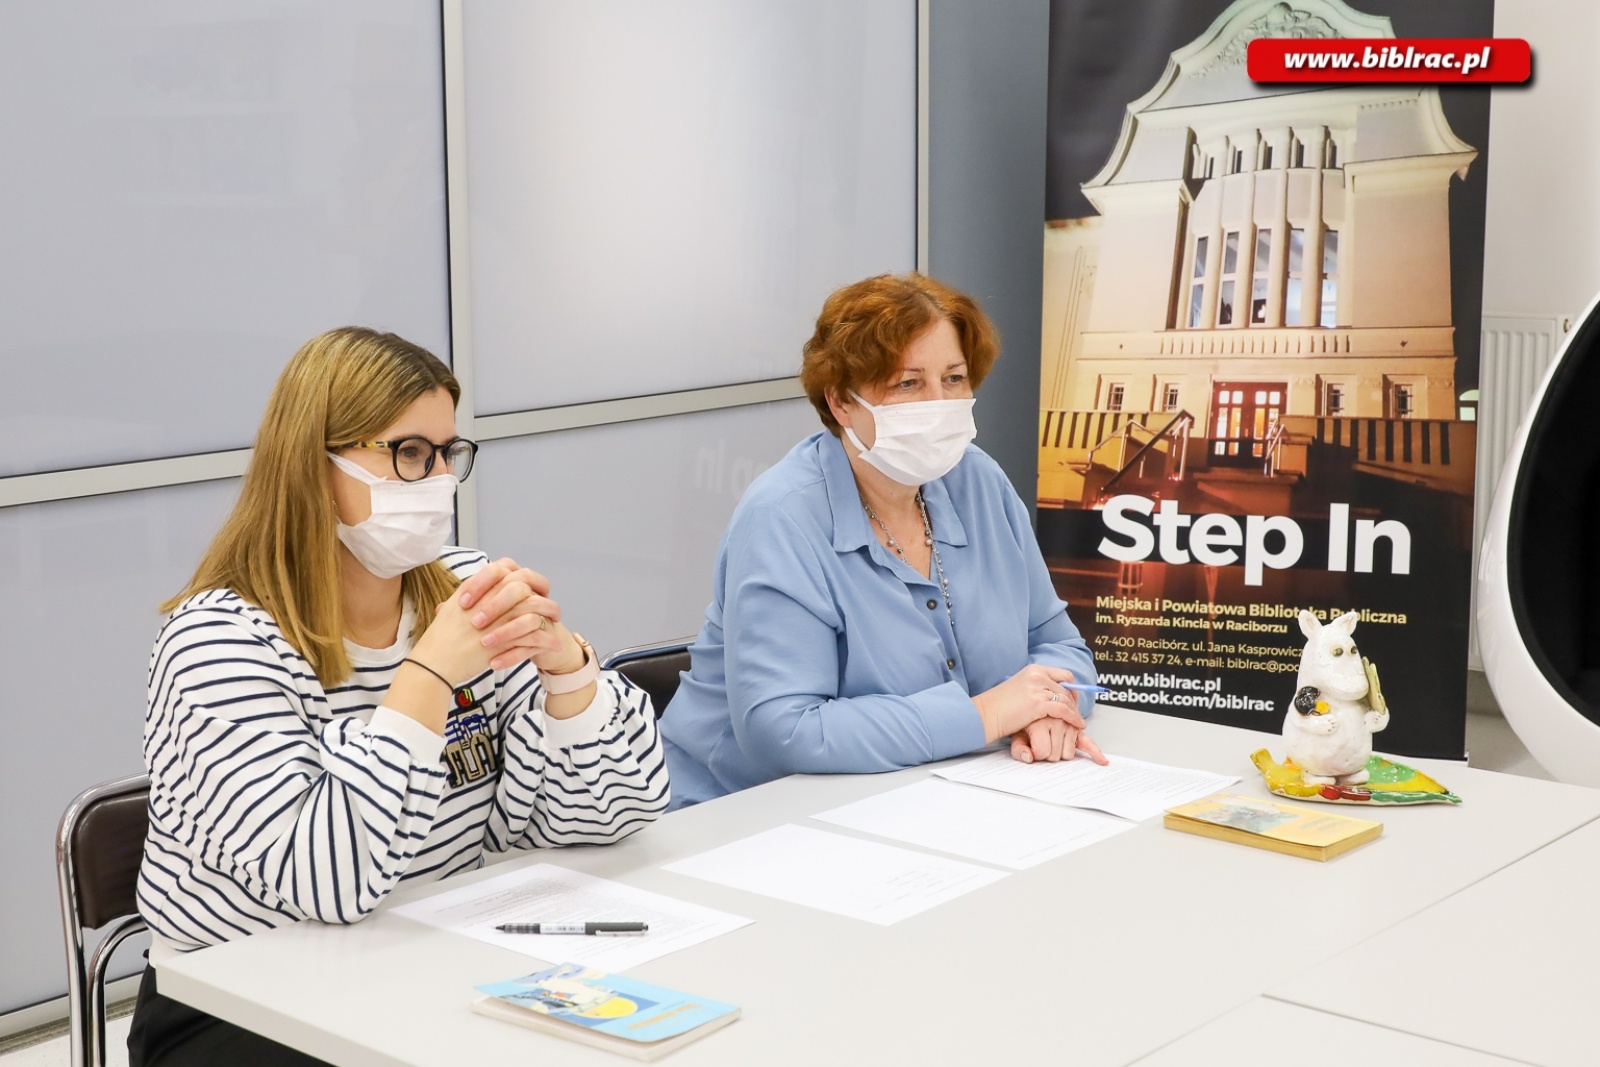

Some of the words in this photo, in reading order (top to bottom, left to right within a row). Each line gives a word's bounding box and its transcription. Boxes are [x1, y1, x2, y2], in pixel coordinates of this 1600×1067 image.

[1097, 494, 1304, 586] Step
[1327, 502, 1412, 575] In
[1096, 596, 1152, 612] Miejska
[1154, 598, 1159, 611] i
[1162, 599, 1247, 616] Powiatowa
[1249, 603, 1327, 620] Bibliotka
[1330, 607, 1407, 624] Pliczna
[1095, 612, 1114, 624] im.
[1116, 614, 1171, 627] Ryszarda
[1172, 617, 1210, 629] Kincla
[1212, 620, 1224, 630] w
[1226, 620, 1288, 633] Raciborzu
[1094, 635, 1135, 648] 47-400
[1192, 641, 1205, 652] ul.
[1207, 641, 1235, 653] Jana
[1115, 651, 1129, 662] 32
[1131, 652, 1150, 663] 415
[1151, 653, 1165, 664] 37
[1185, 657, 1224, 668] e-mail:
[1096, 672, 1222, 694] www.biblrac.pl
